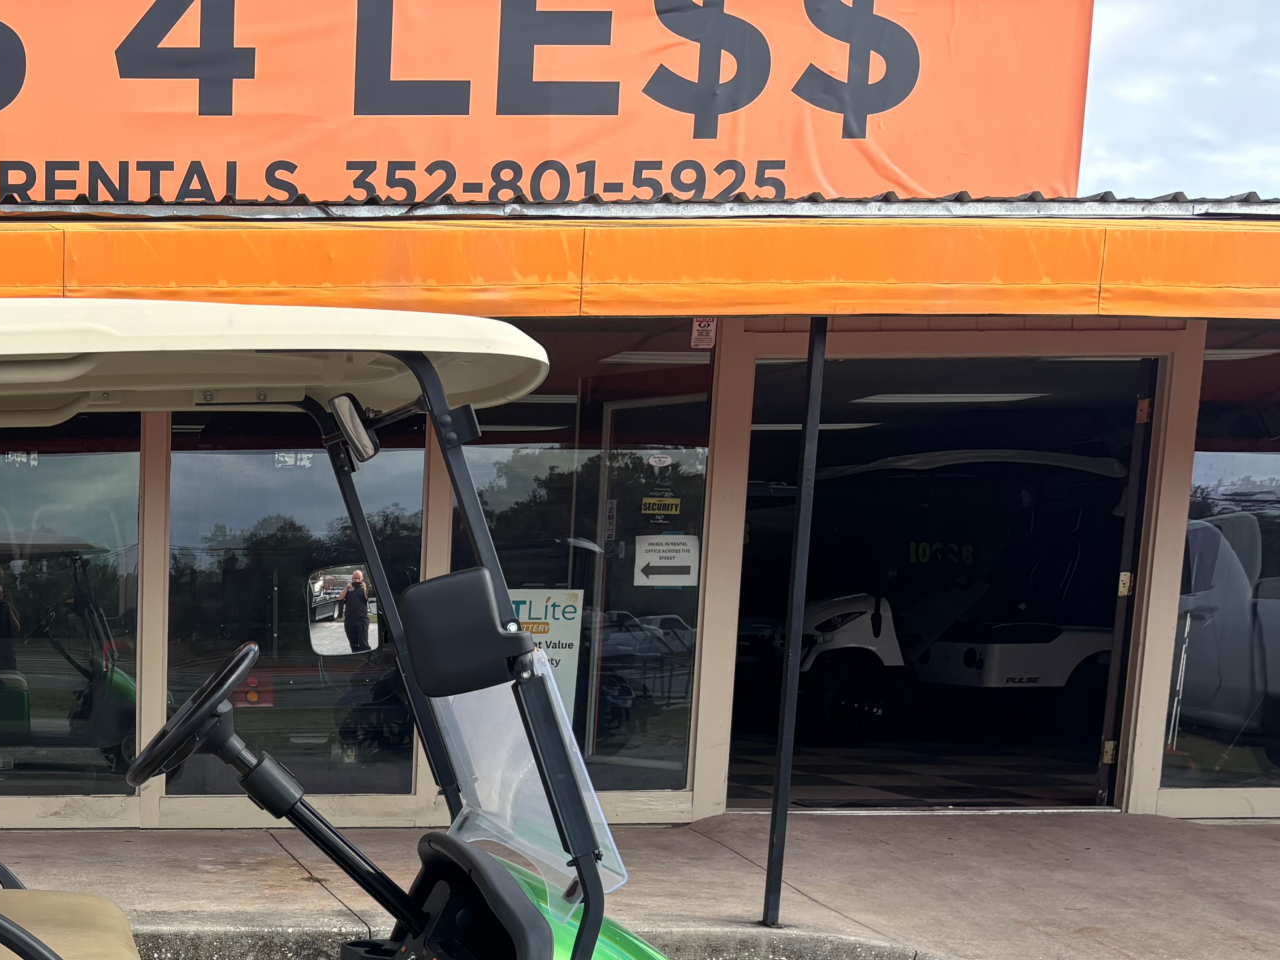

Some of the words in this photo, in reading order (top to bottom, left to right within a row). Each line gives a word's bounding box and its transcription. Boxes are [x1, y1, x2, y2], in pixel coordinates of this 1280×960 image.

[114, 0, 257, 117] 4
[643, 503, 679, 512] SECURITY
[545, 640, 574, 650] Value
[1005, 676, 1040, 684] PULSE
